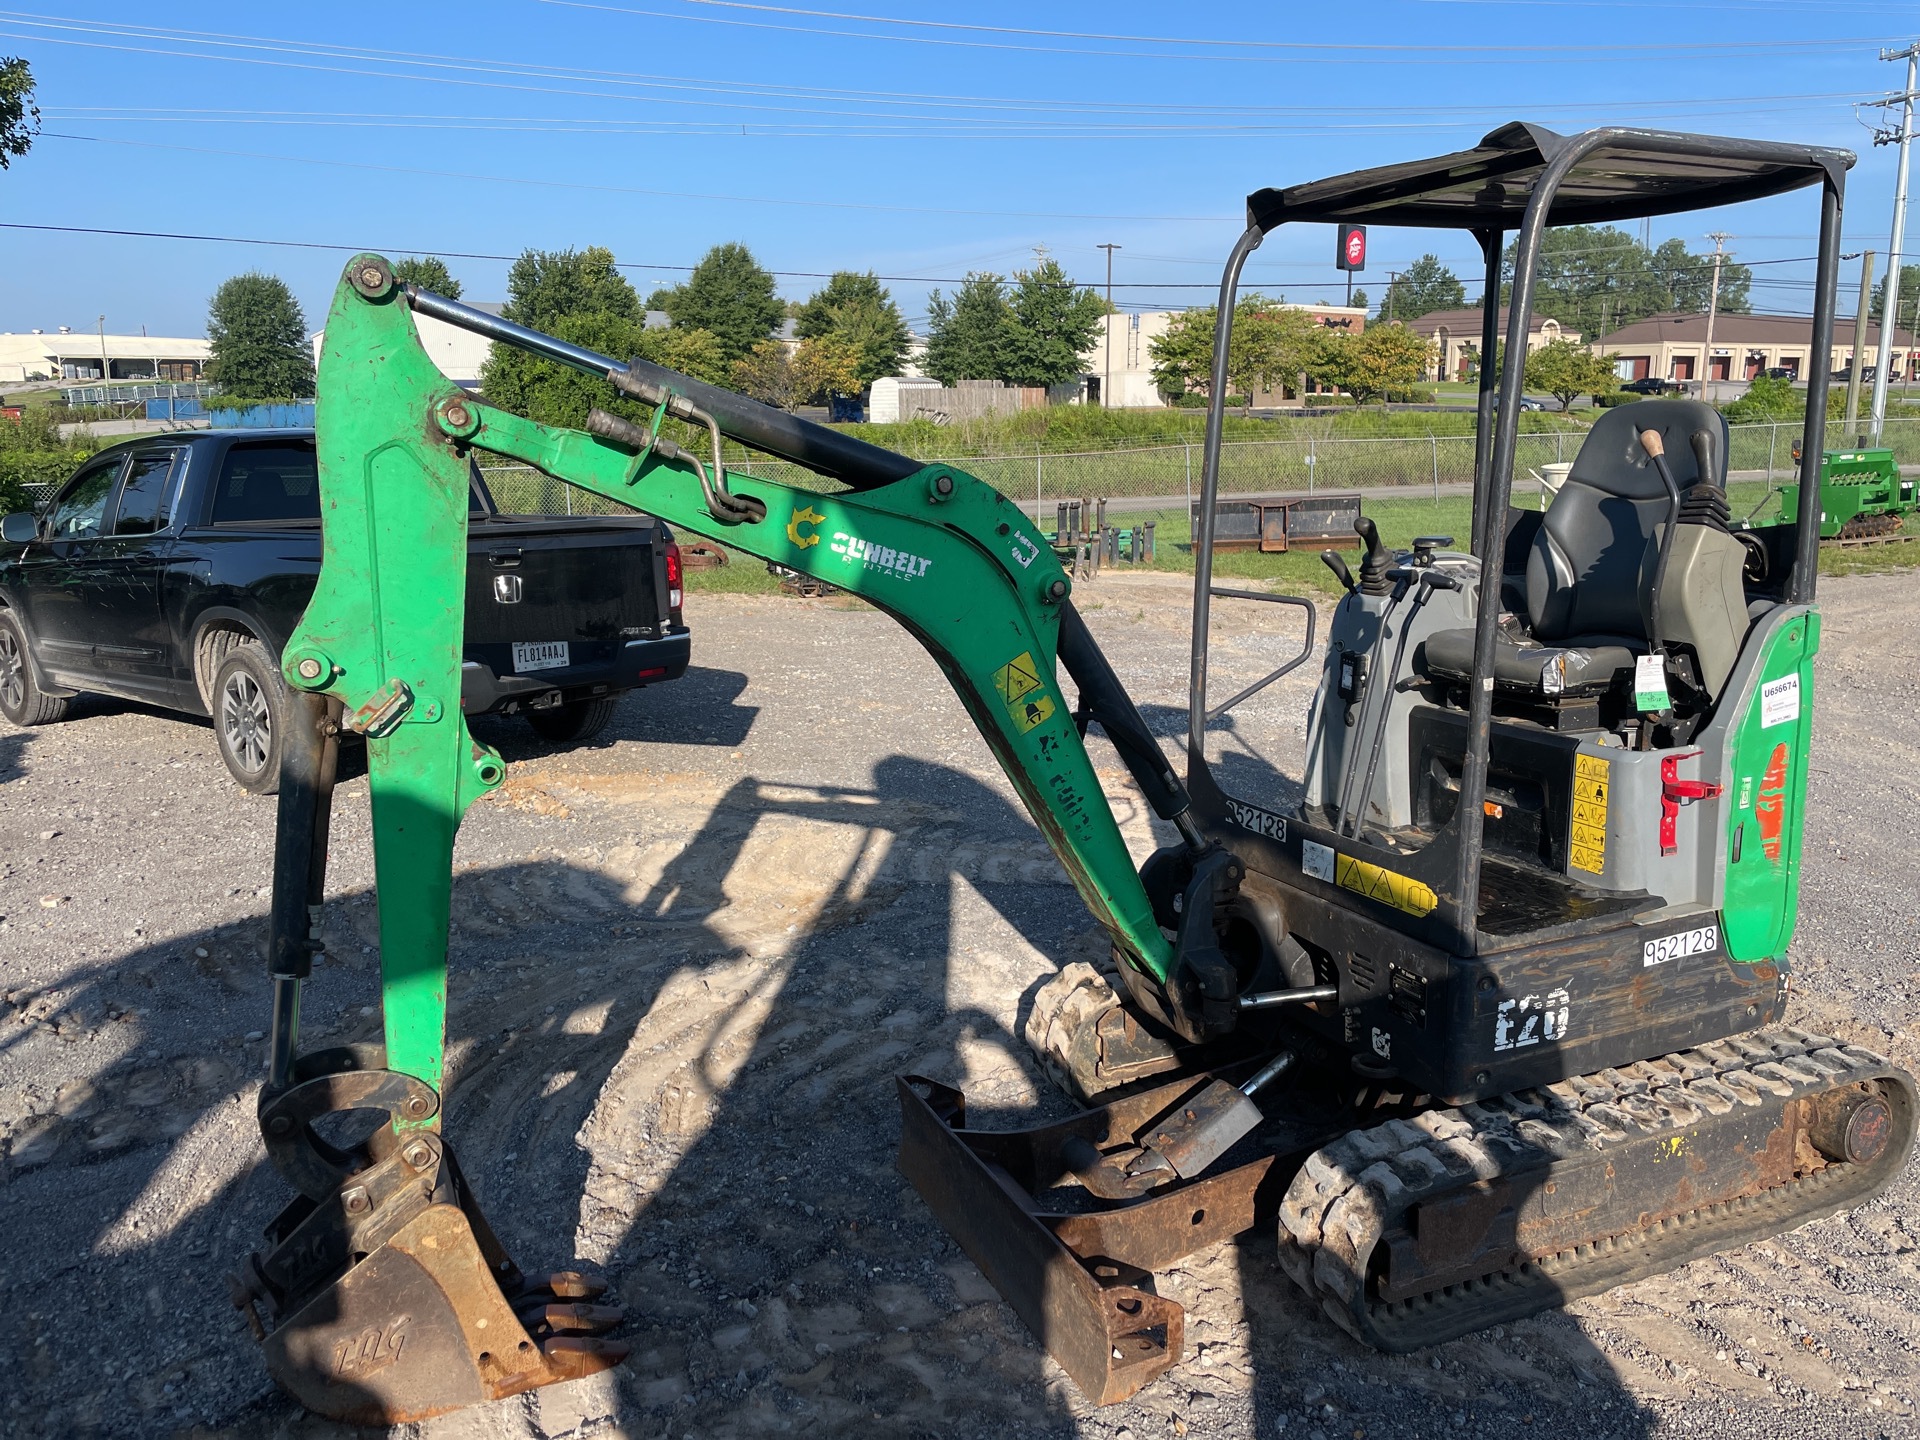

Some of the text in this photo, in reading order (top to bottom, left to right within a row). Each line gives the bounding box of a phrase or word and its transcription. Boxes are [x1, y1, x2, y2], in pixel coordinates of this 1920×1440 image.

[831, 532, 932, 577] SUNBELT
[842, 555, 914, 582] RNTALS
[518, 644, 565, 664] FL814AAJ
[1764, 680, 1797, 698] U656674
[1645, 928, 1715, 963] 952128
